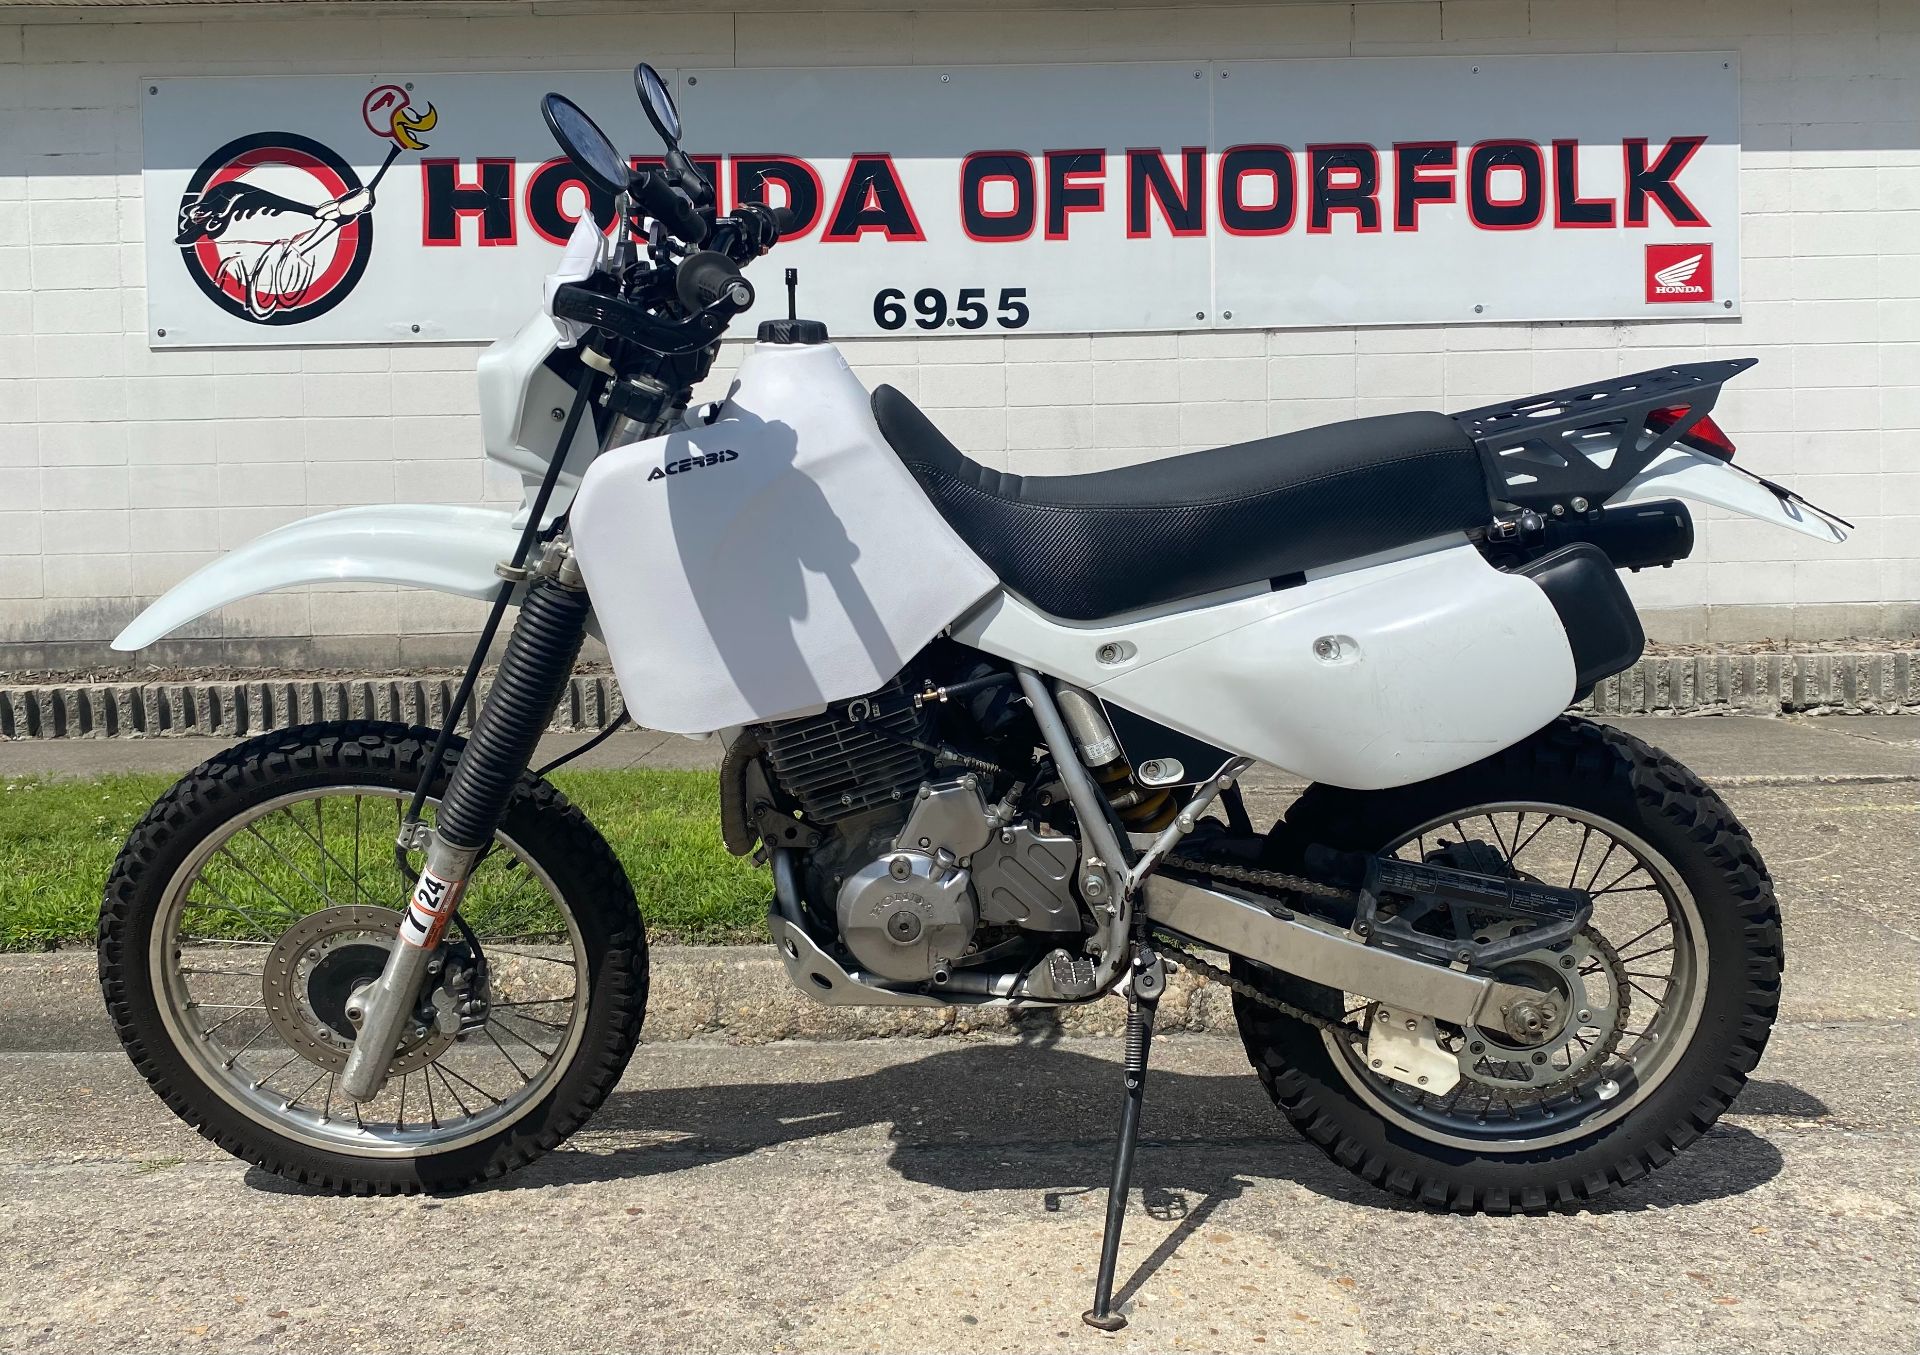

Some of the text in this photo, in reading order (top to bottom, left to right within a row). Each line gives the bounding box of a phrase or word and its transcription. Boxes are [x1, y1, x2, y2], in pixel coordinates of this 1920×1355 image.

[959, 148, 1107, 243] OF
[1125, 136, 1711, 239] NORFOLK
[873, 287, 1030, 330] 6955
[1655, 285, 1705, 294] HONDA
[418, 876, 446, 909] 24
